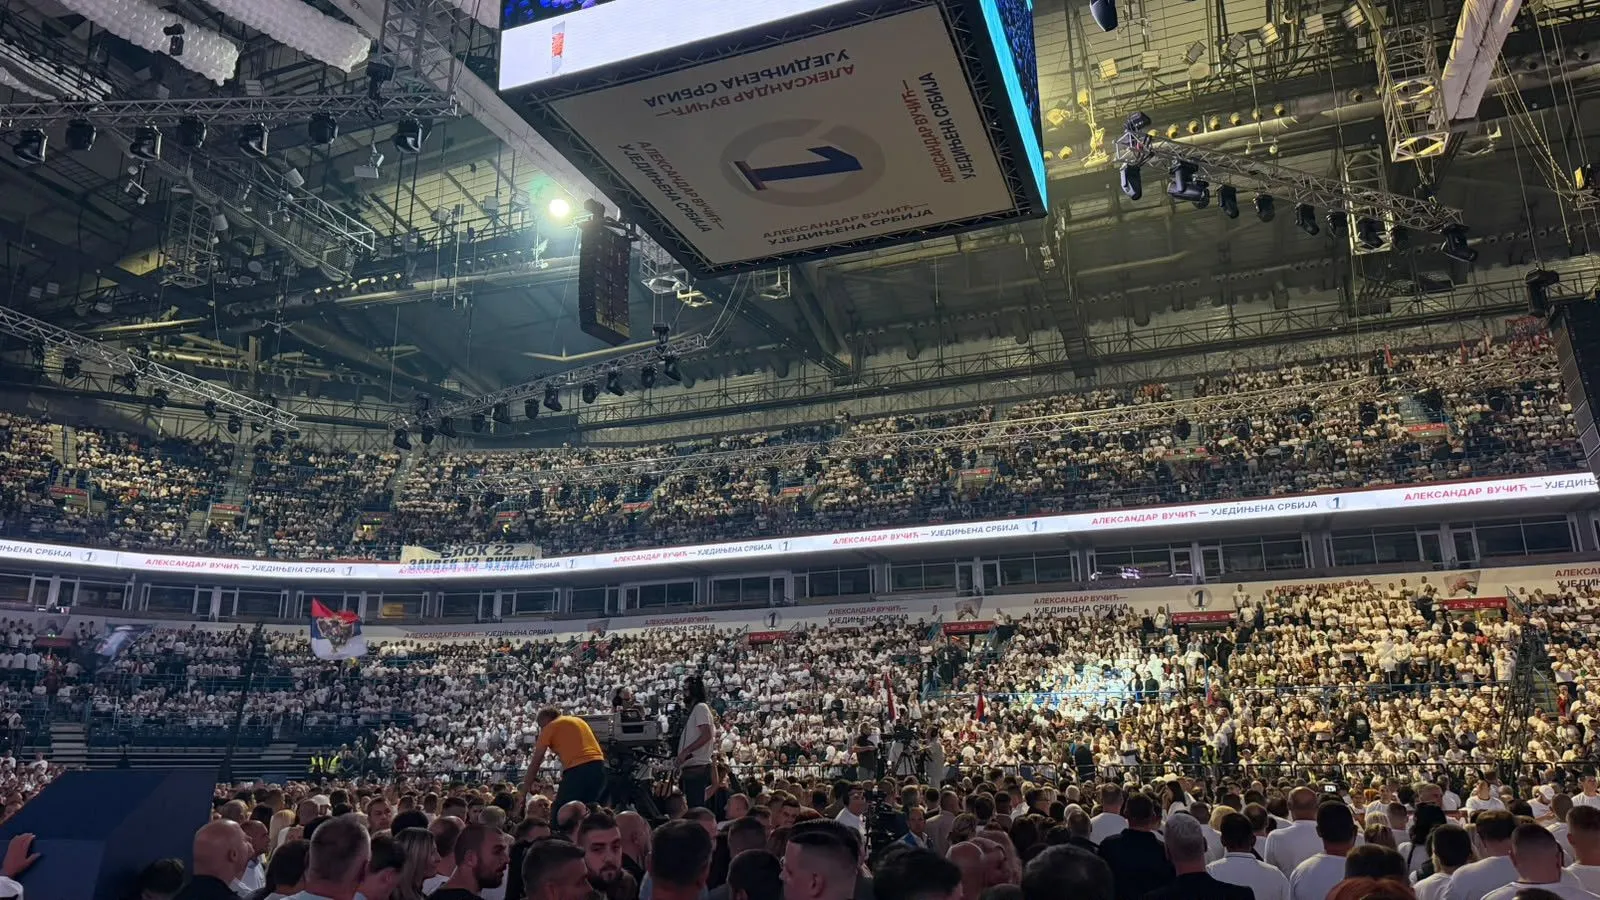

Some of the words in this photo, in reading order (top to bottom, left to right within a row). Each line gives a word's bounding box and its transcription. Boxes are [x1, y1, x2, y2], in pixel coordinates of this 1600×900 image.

[721, 49, 850, 90] УЈЕДИЊЕНА
[734, 64, 855, 103] АЛЕКСАНДАР
[643, 82, 717, 108] СРБИЈА
[918, 72, 950, 118] СРБИЈА
[918, 125, 956, 183] АЛЕКСАНДАР
[938, 118, 976, 180] УЈЕДИЊЕНА
[638, 141, 698, 201] АЛЕКСАНДАР
[727, 144, 864, 192] 1
[617, 143, 682, 202] УЈЕДИЊЕНА
[675, 202, 713, 233] СРБИЈА
[763, 215, 860, 239] АЛЕКСАНДАР
[768, 222, 867, 246] УЈЕДИЊЕНА
[870, 208, 934, 227] СРБИЈА
[1404, 487, 1482, 501] АЛЕКСАНДАР
[1487, 484, 1528, 495] ВУЧИЋ
[1091, 512, 1159, 526] АЛЕКСАНДАР
[1162, 510, 1197, 521] ВУЧИЋ
[1210, 504, 1275, 517] УЈЕДИЊЕНА
[1277, 500, 1318, 511] СРБИЈА
[1331, 496, 1340, 510] 1
[832, 534, 888, 545] АЛЕКСАНДАР
[890, 531, 919, 540] ВУЧИЋ
[930, 525, 984, 537] УЈЕДИЊЕНА
[985, 523, 1019, 533] СРБИЈА
[1031, 520, 1038, 533] 1
[35, 547, 72, 558] СРБИЈА
[86, 551, 93, 562] 1
[493, 544, 515, 556] 22
[612, 552, 661, 563] АЛЕКСАНДАР
[662, 550, 688, 559] ВУЧИЋ
[697, 546, 743, 557] УЈЕДИЊЕНА
[744, 543, 773, 552] СРБИЈА
[782, 541, 789, 552] 1
[145, 559, 207, 569] АЛЕКСАНДАР
[209, 562, 240, 570] ВУЧИЋ
[251, 564, 303, 573] УЈЕДИЊЕНА
[305, 566, 336, 574] СРБИЈА
[346, 566, 353, 576] 1
[1033, 595, 1089, 605] АЛЕКСАНДАР
[1194, 589, 1204, 609] 1
[769, 611, 777, 628] 1
[828, 606, 876, 616] АЛЕКСАНДАР
[1034, 604, 1091, 615] УЈЕДИЊЕНА
